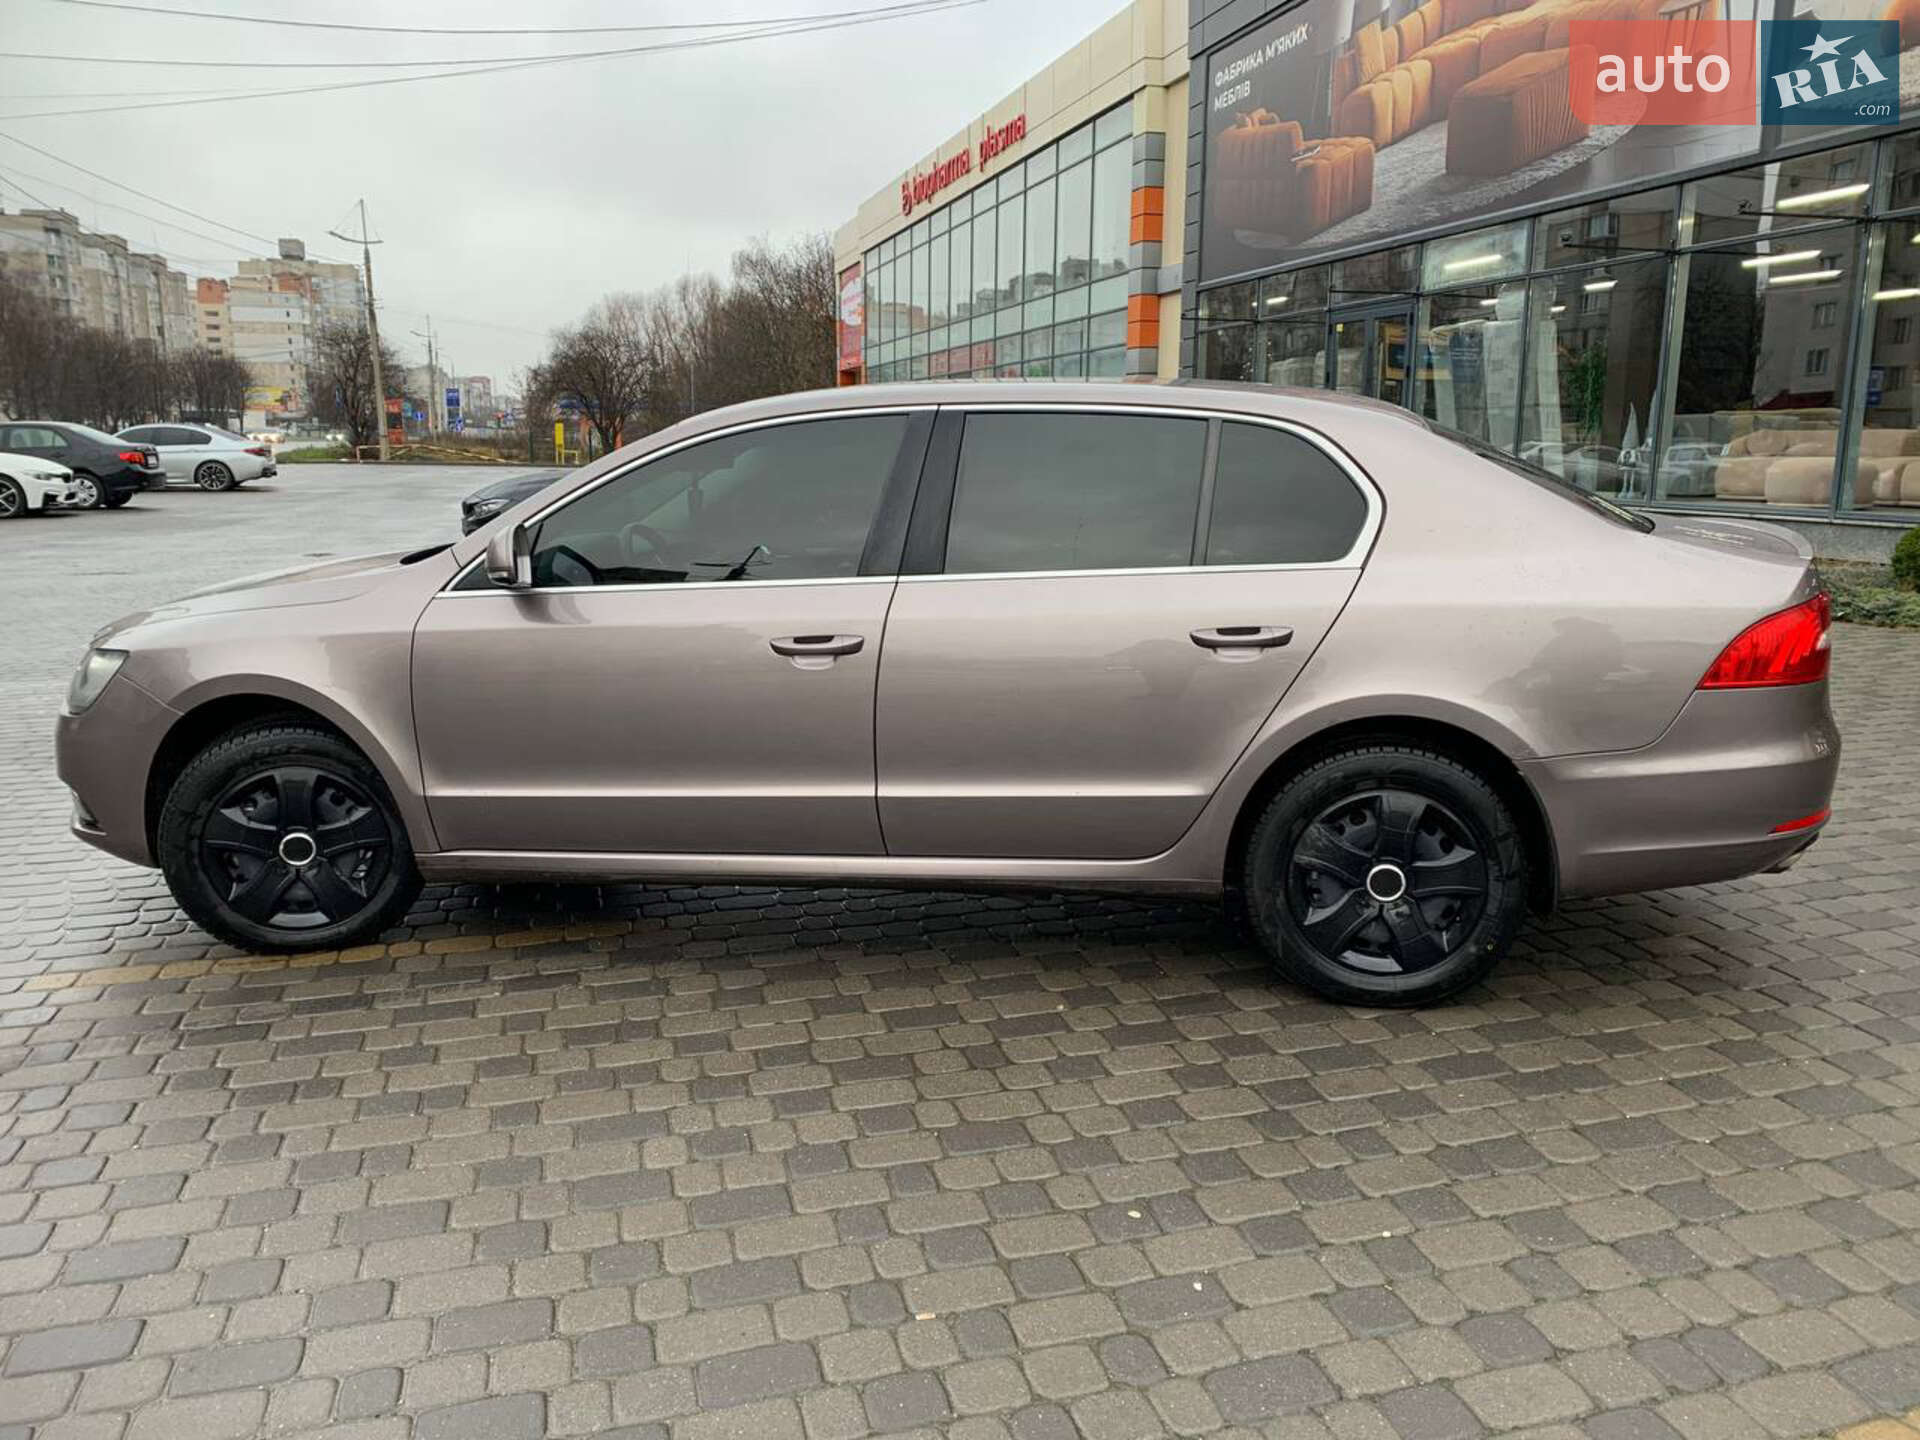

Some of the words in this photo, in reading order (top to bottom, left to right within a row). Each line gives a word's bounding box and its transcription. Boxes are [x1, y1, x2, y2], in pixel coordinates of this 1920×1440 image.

[1215, 49, 1263, 87] ФАБРИКА
[1214, 80, 1251, 111] МЕБЛІВ
[912, 148, 970, 205] biopharma
[979, 114, 1026, 172] plasma
